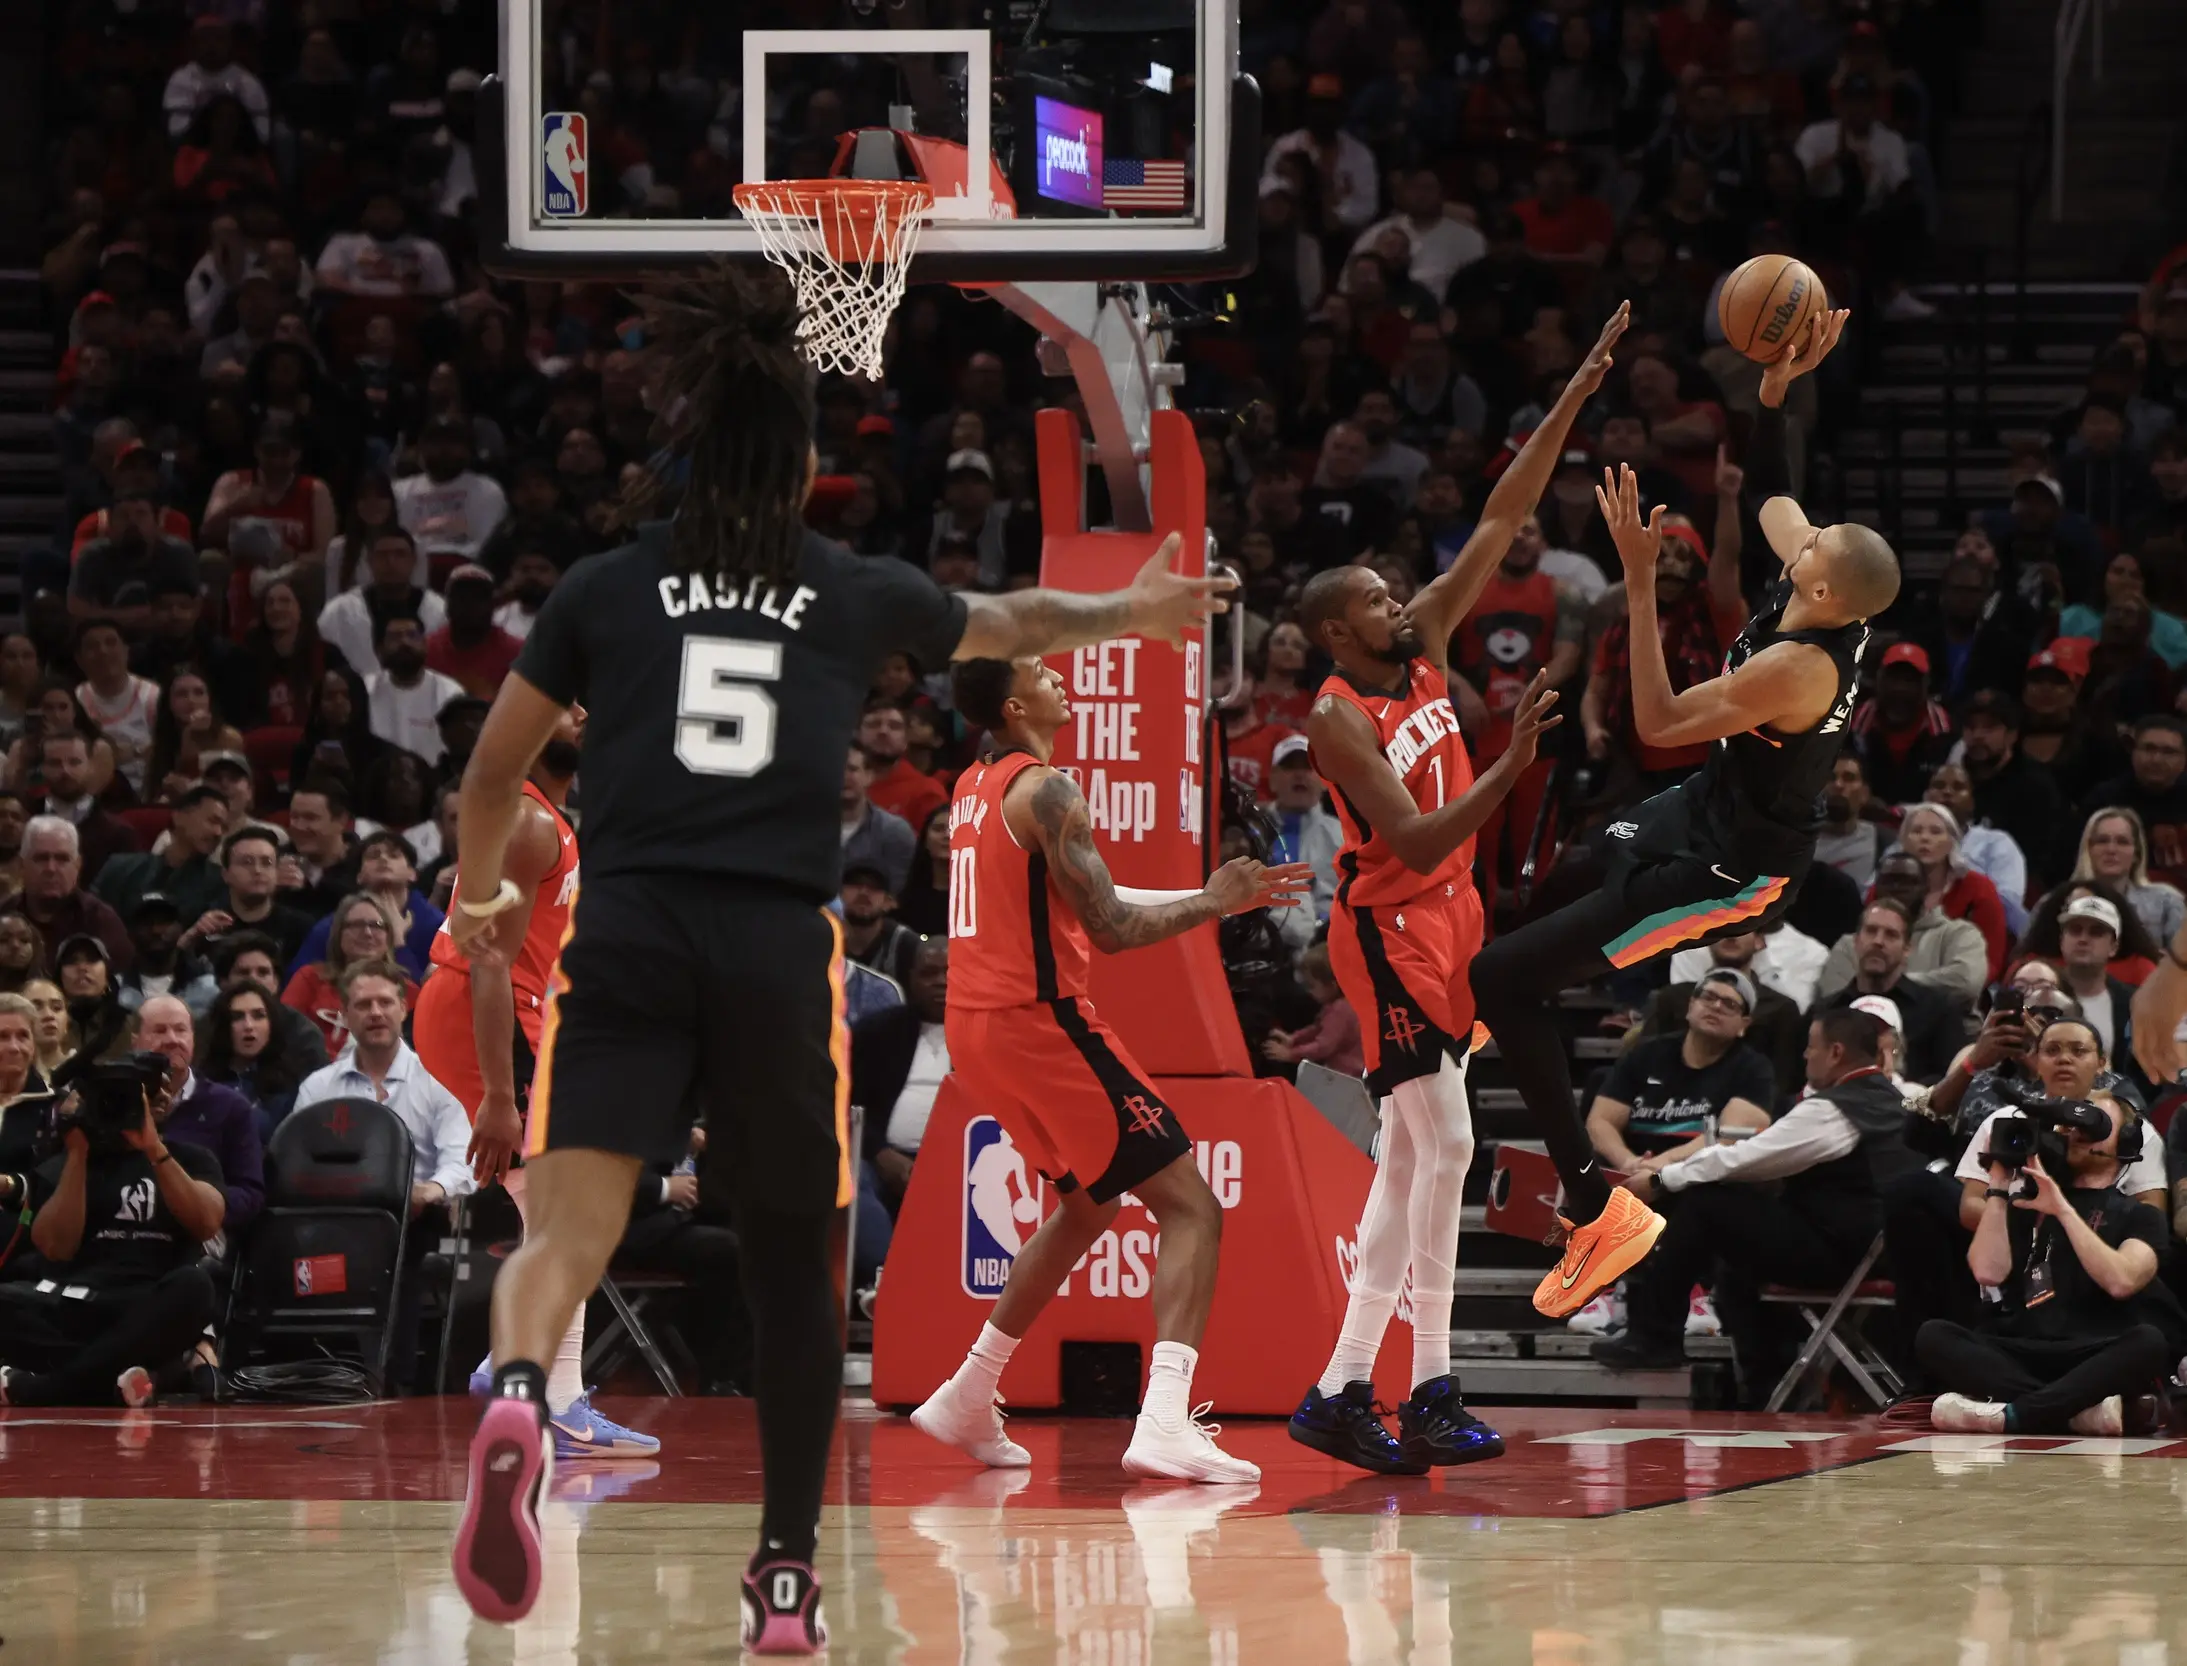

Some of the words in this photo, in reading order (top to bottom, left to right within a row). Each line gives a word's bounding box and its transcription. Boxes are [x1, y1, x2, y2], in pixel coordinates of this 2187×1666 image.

[1046, 128, 1088, 186] peacock
[548, 193, 570, 209] NBA
[1760, 279, 1805, 344] Wilson
[658, 571, 818, 631] CASTLE
[1072, 638, 1142, 697] GET
[673, 633, 784, 778] 5
[1070, 703, 1142, 761] THE
[1089, 768, 1156, 842] App
[948, 846, 977, 940] 10
[1631, 1096, 1656, 1118] San
[1656, 1097, 1712, 1121] Antonio
[974, 1258, 1009, 1287] NBA
